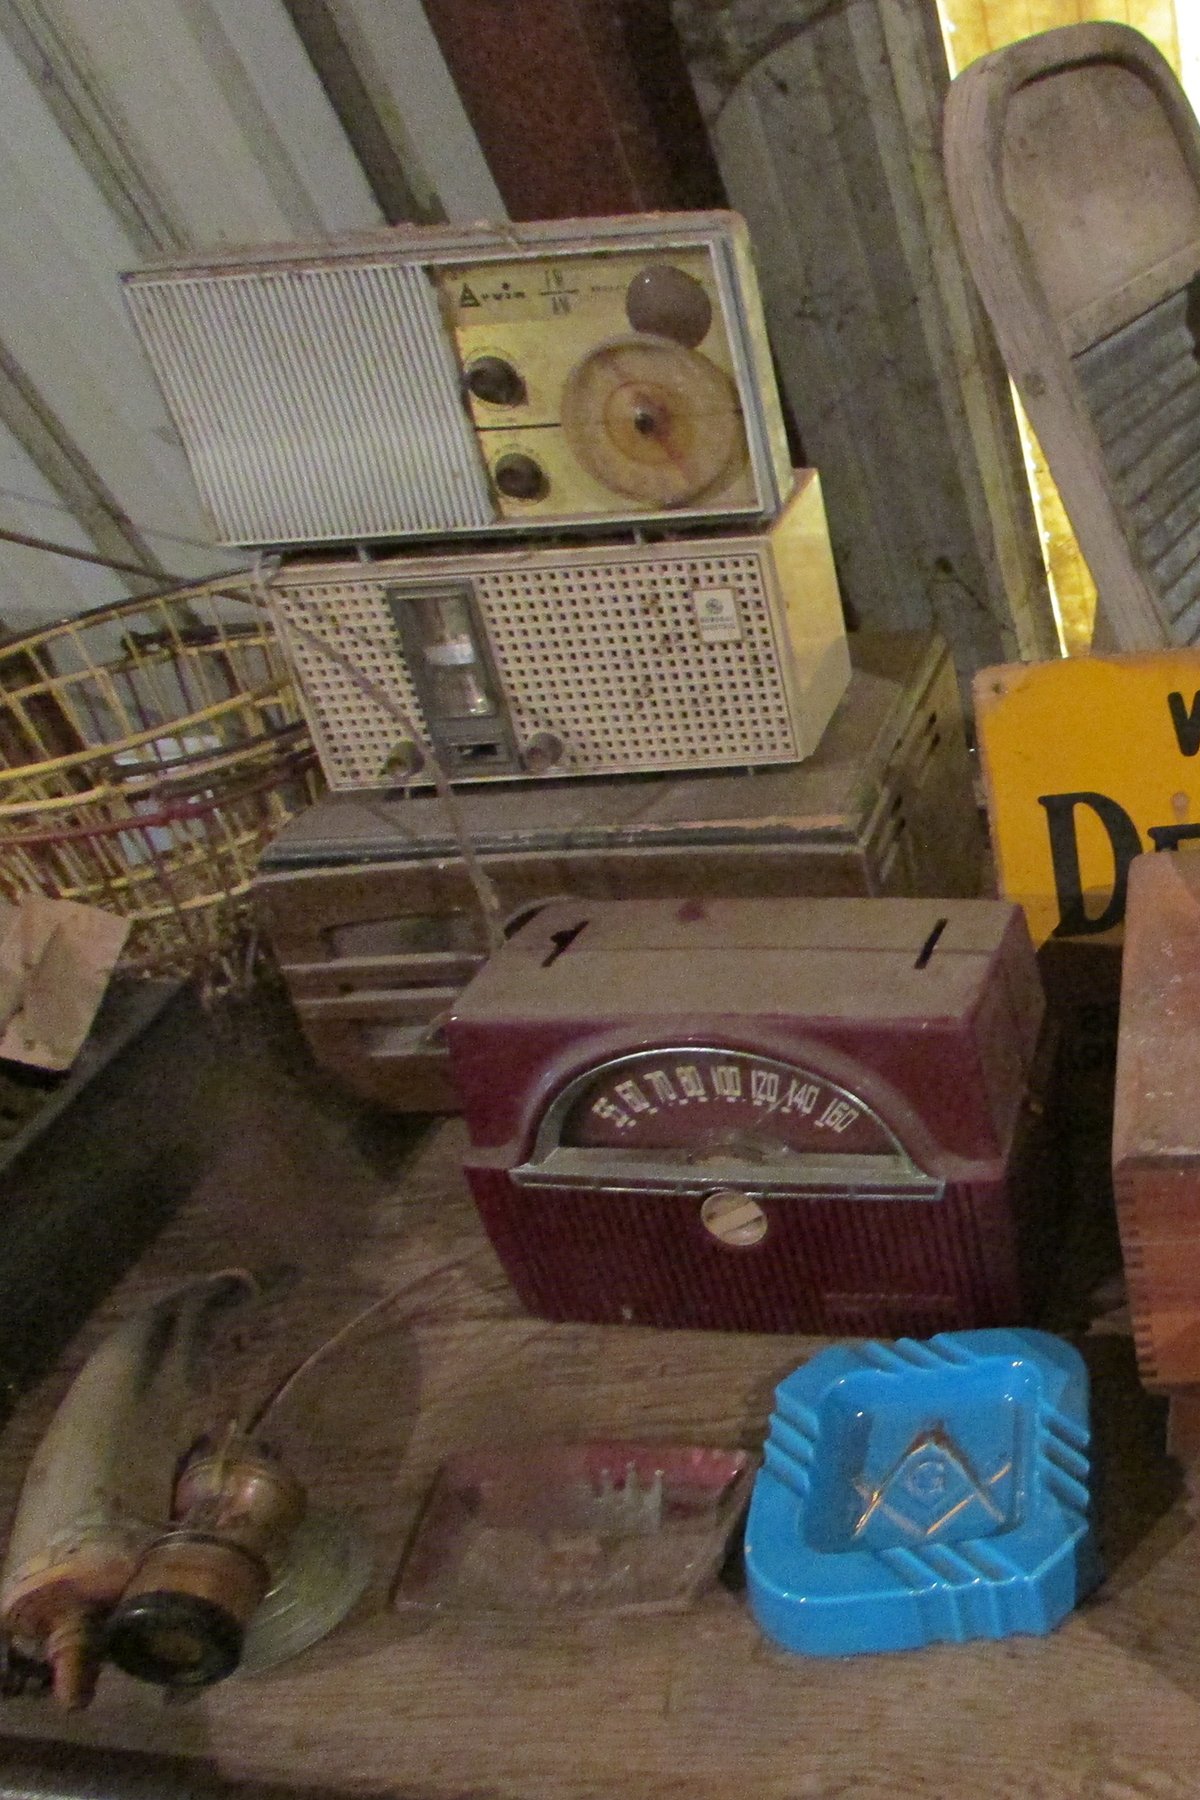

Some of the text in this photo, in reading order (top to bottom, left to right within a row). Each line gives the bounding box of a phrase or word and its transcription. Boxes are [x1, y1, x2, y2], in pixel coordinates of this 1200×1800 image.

[710, 1065, 742, 1098] 100
[751, 1069, 780, 1103] 120
[787, 1078, 820, 1115] 140
[819, 1097, 860, 1134] 160
